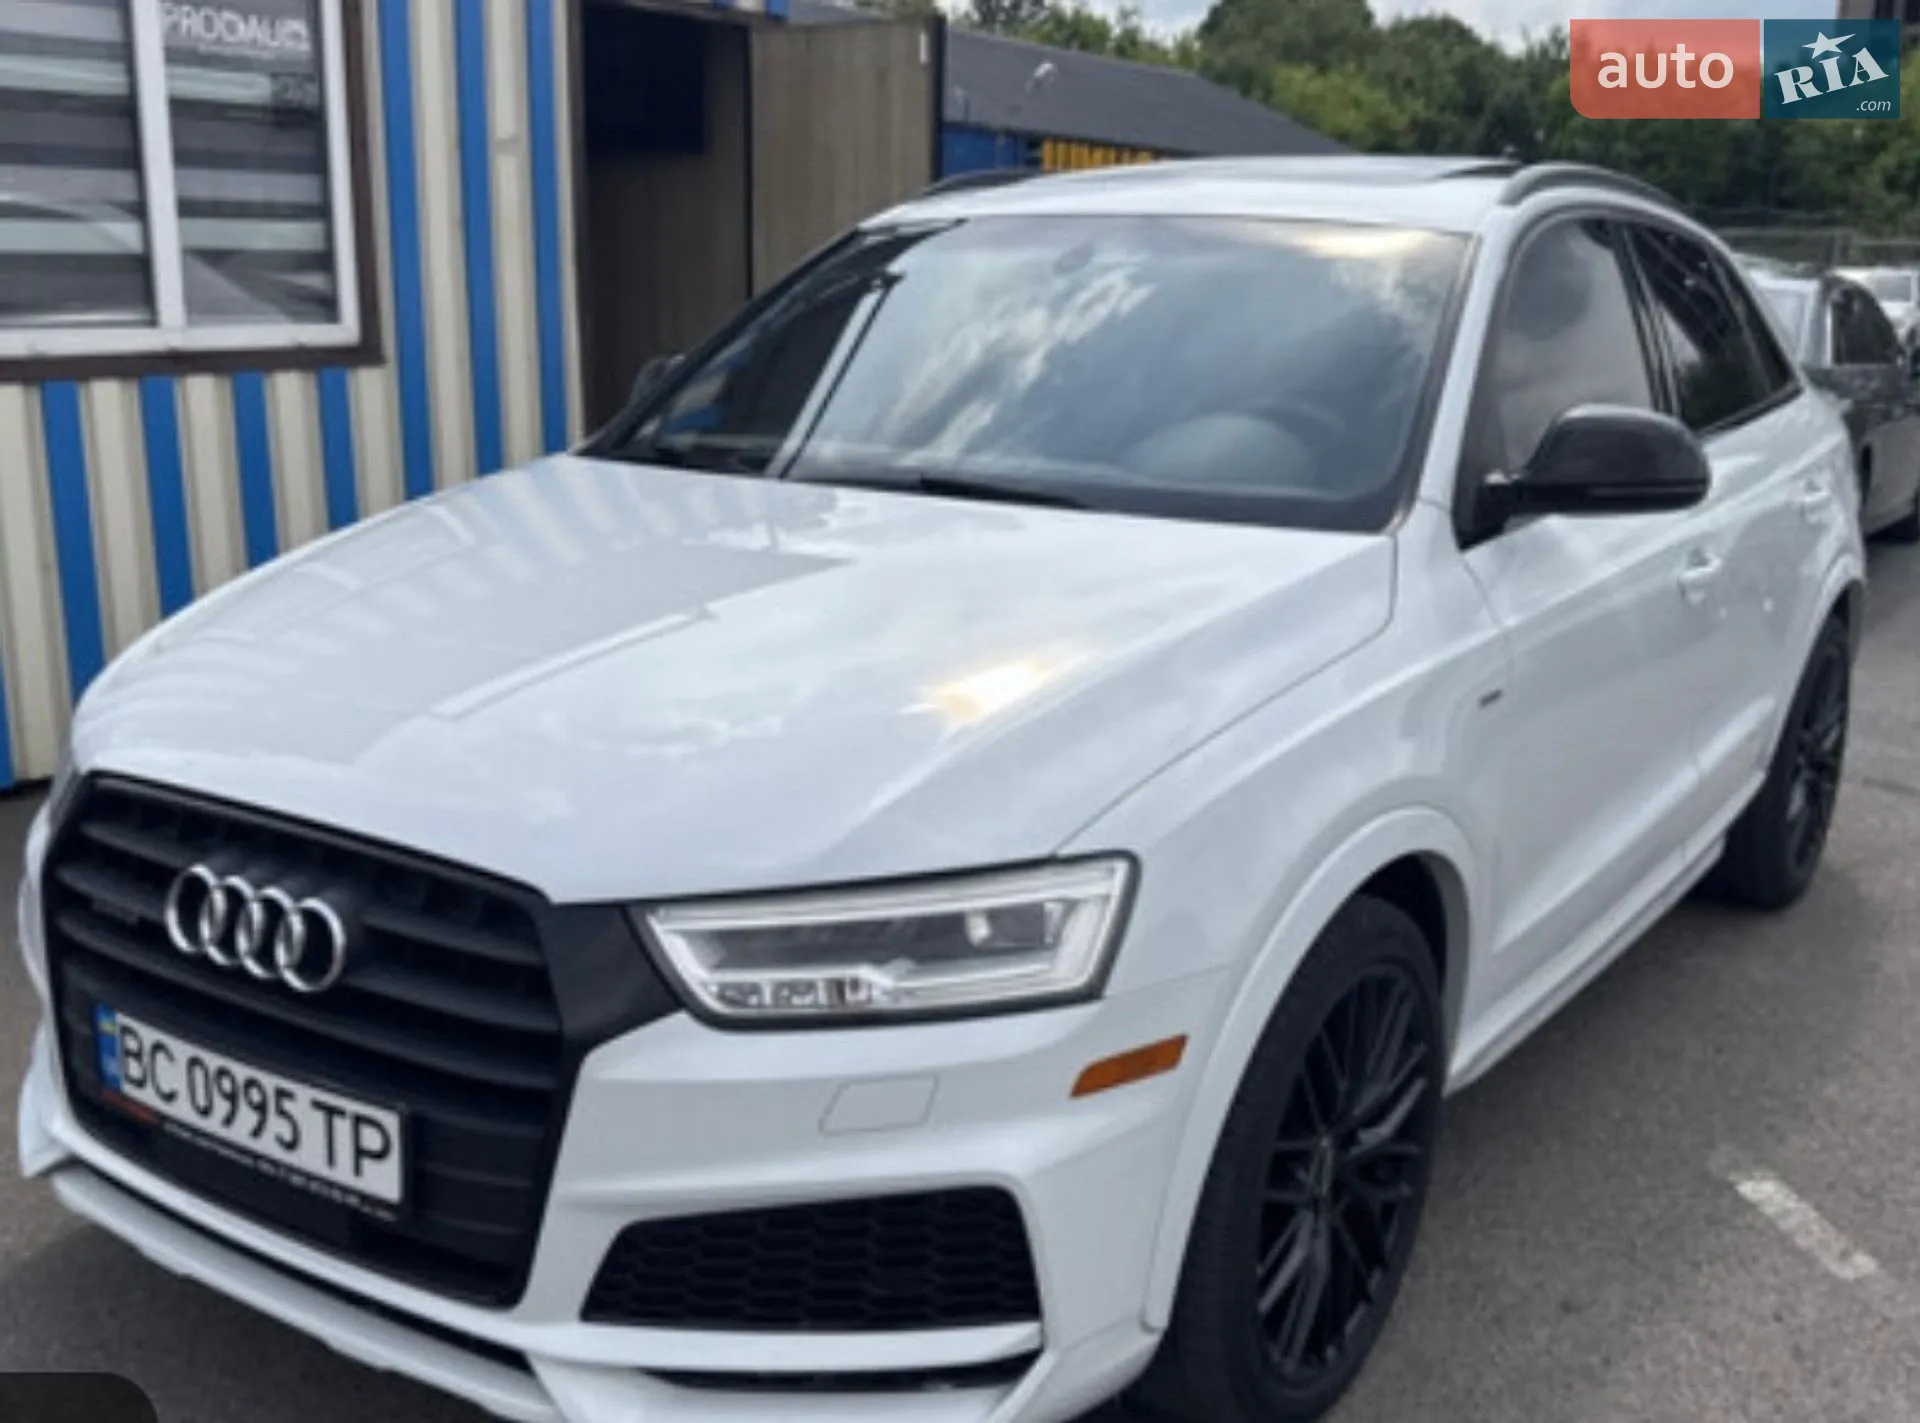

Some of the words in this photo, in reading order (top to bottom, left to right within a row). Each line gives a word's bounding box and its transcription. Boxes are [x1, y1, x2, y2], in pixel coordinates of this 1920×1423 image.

[119, 1024, 178, 1105] BC
[186, 1056, 300, 1151] 0995
[309, 1098, 392, 1178] TP
